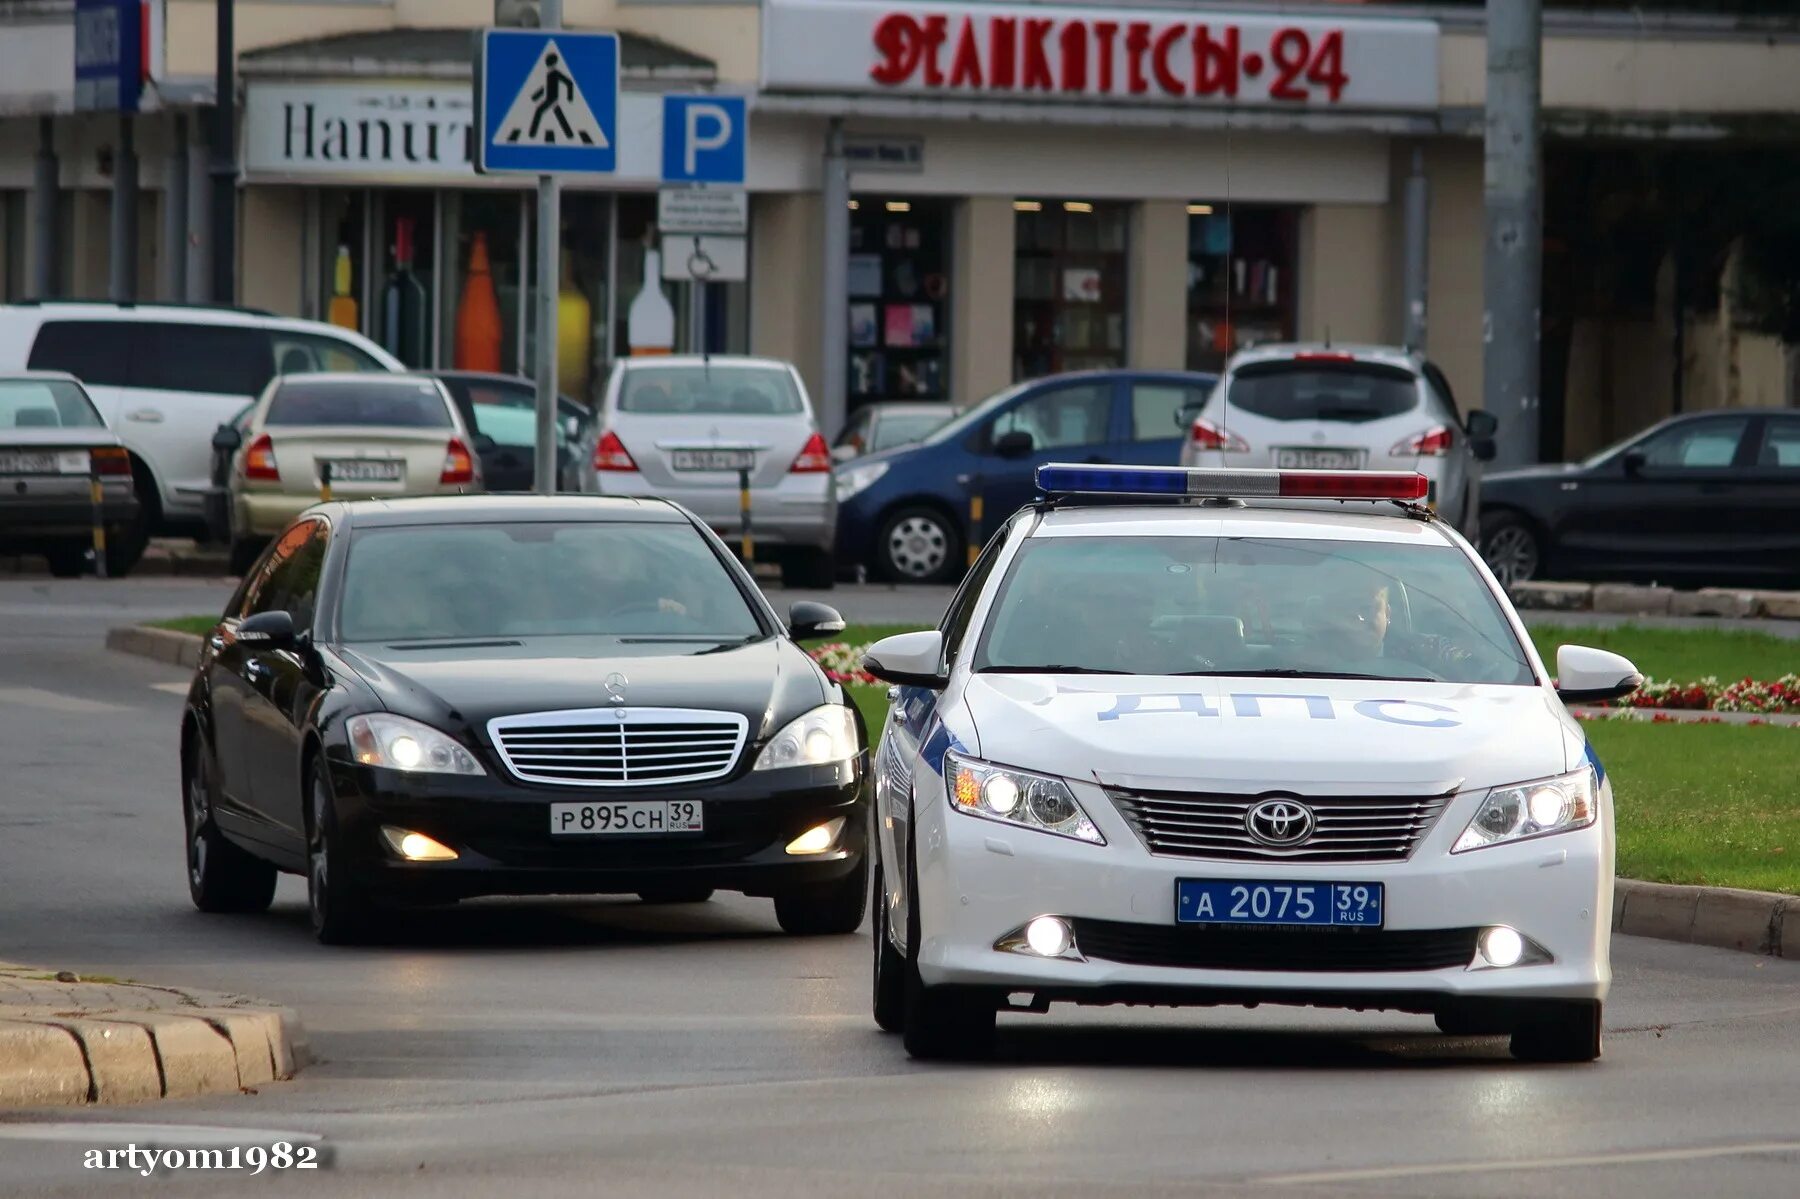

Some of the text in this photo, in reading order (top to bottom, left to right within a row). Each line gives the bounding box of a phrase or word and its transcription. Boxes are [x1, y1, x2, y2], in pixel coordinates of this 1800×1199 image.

[684, 104, 732, 175] P
[1097, 693, 1463, 728] ДПС
[669, 821, 688, 829] RUS
[670, 803, 694, 821] 39
[1230, 886, 1315, 919] 2075
[1336, 885, 1369, 910] 39
[1340, 911, 1365, 922] RUS
